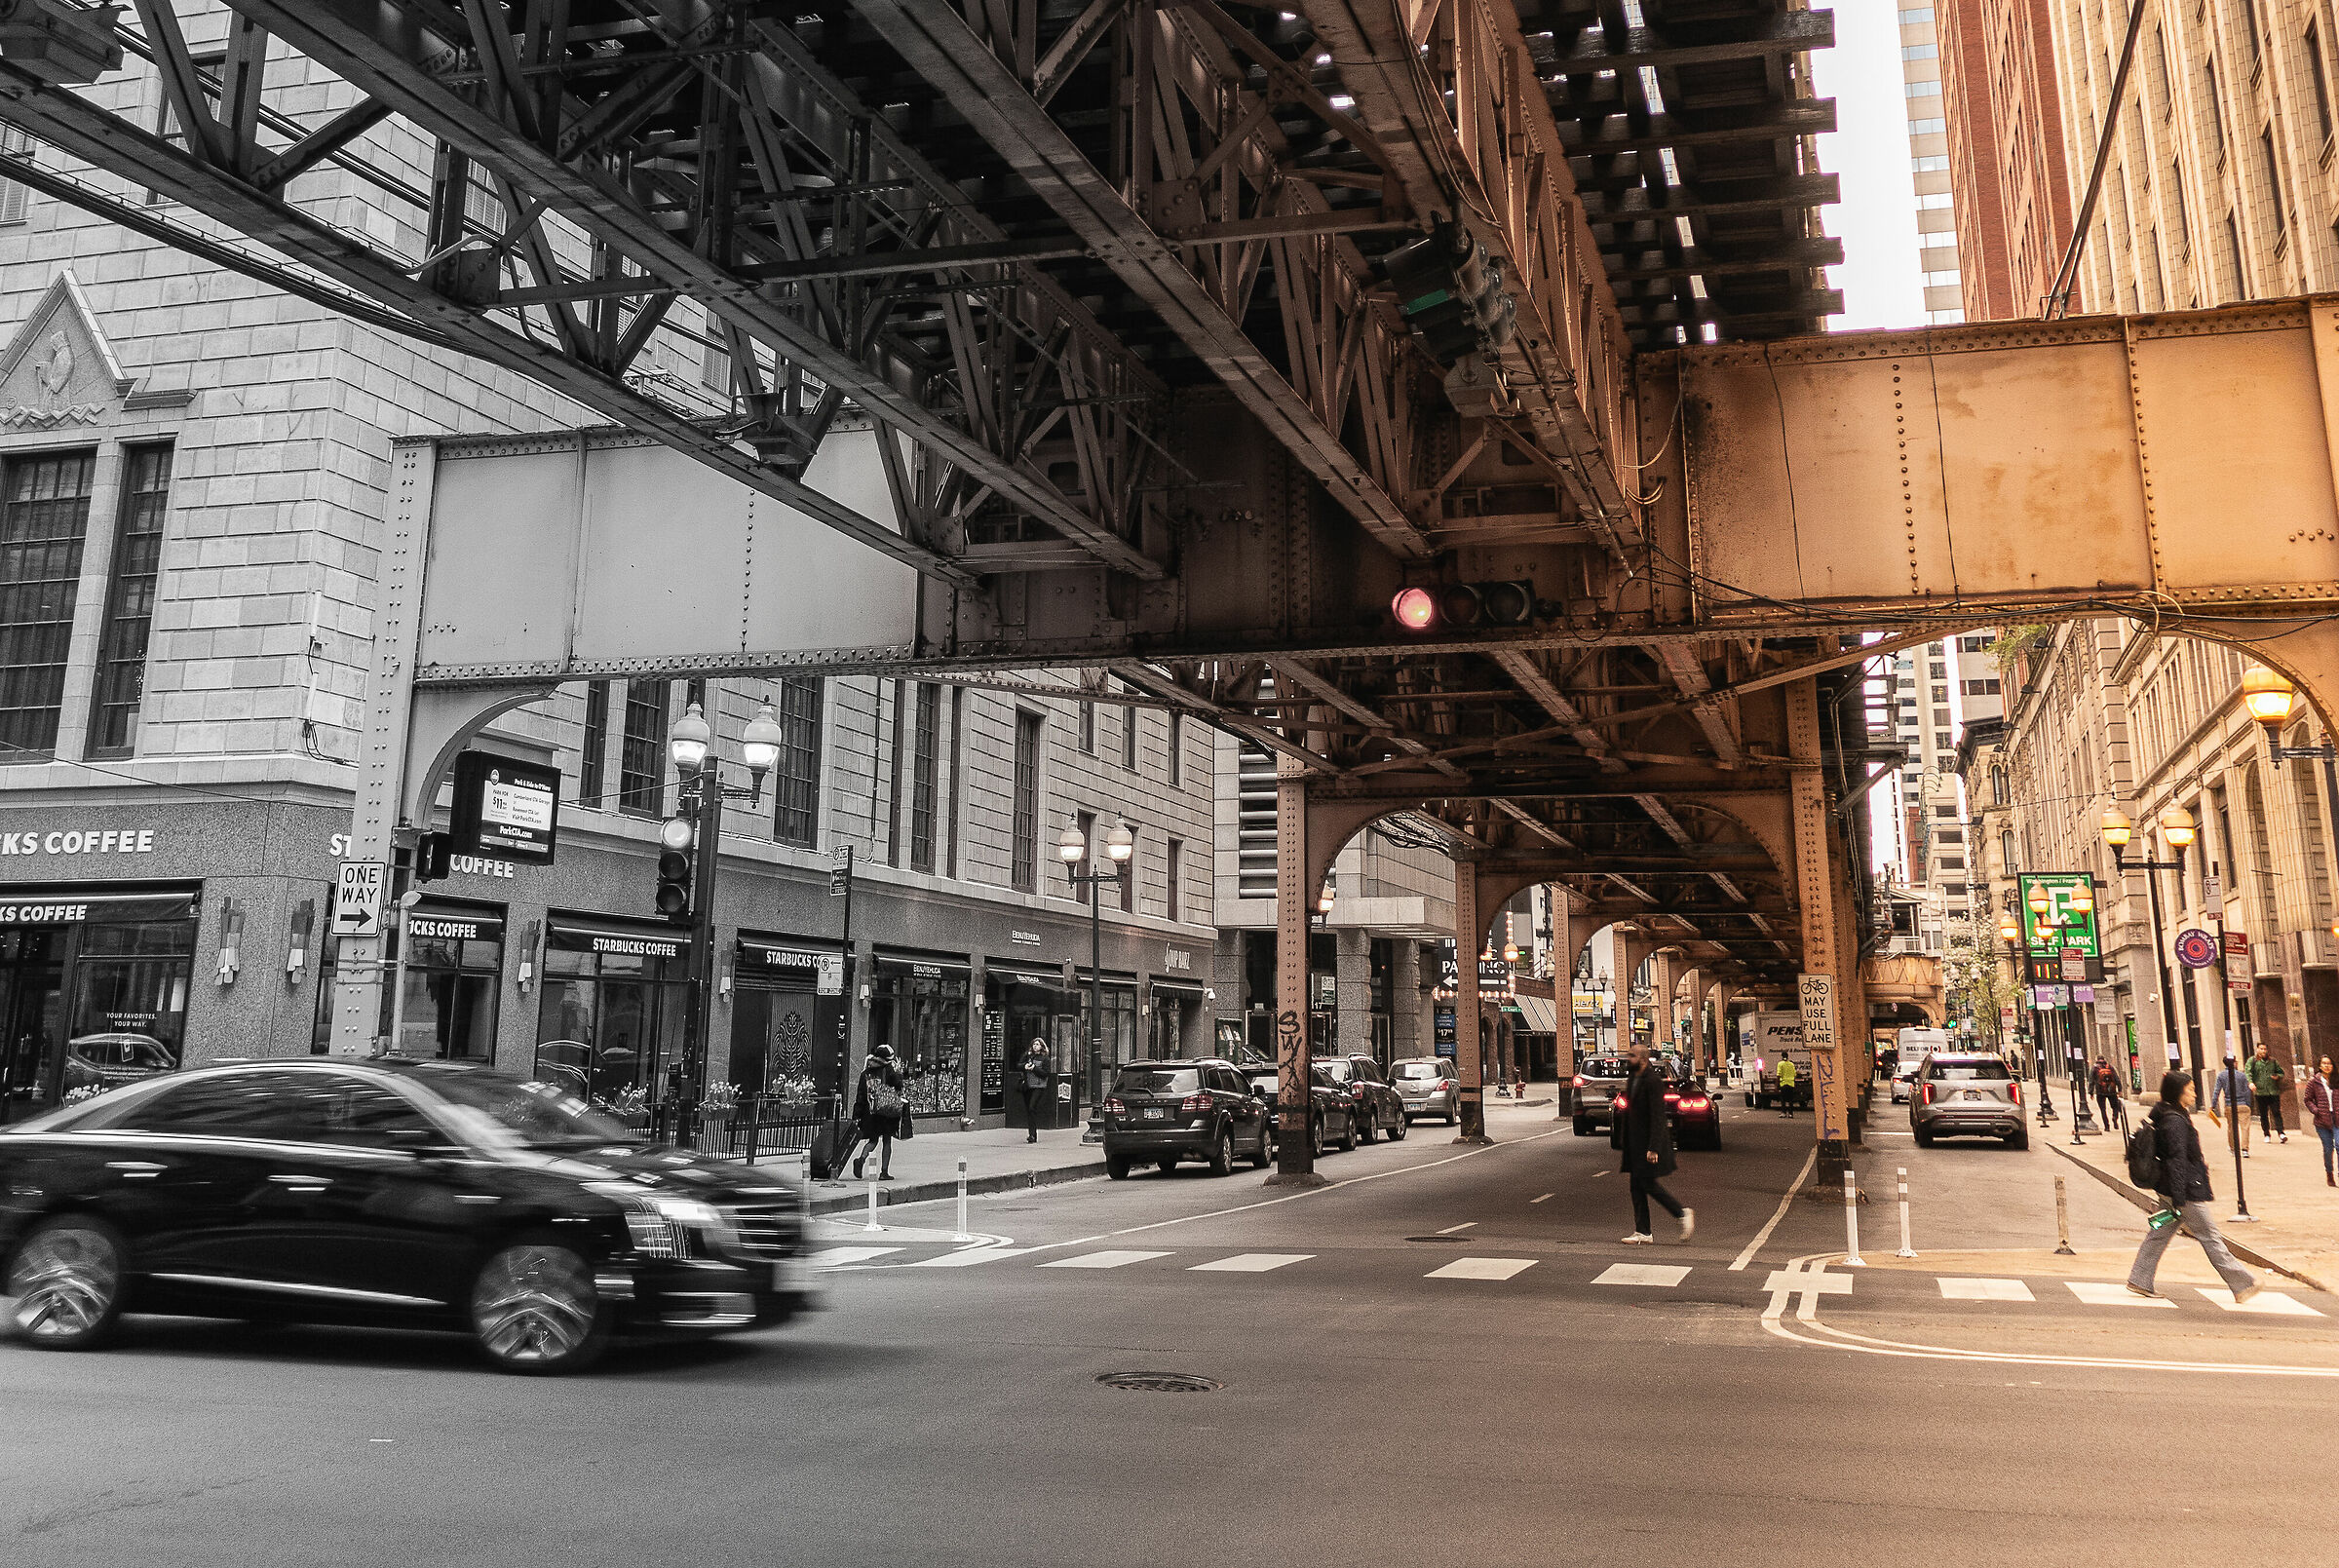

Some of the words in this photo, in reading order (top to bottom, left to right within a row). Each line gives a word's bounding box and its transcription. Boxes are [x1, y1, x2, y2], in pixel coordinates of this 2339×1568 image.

[500, 825, 533, 838] ParkCTA.com
[45, 830, 154, 855] COFFEE
[449, 854, 514, 878] COFFEE
[345, 867, 377, 884] ONE
[342, 888, 377, 903] WAY
[19, 905, 87, 921] COFFEE
[437, 922, 477, 938] COFFEE
[593, 937, 645, 955] STARBUCKS
[645, 942, 676, 957] COFFEE
[766, 950, 812, 967] STARBUCKS
[1442, 961, 1505, 974] PAING
[2036, 963, 2058, 979] 11:
[1804, 997, 1826, 1006] MAY
[1806, 1010, 1826, 1018] USE
[1767, 1026, 1801, 1036] PENS
[1803, 1021, 1831, 1031] FULL
[1804, 1034, 1831, 1043] LANE
